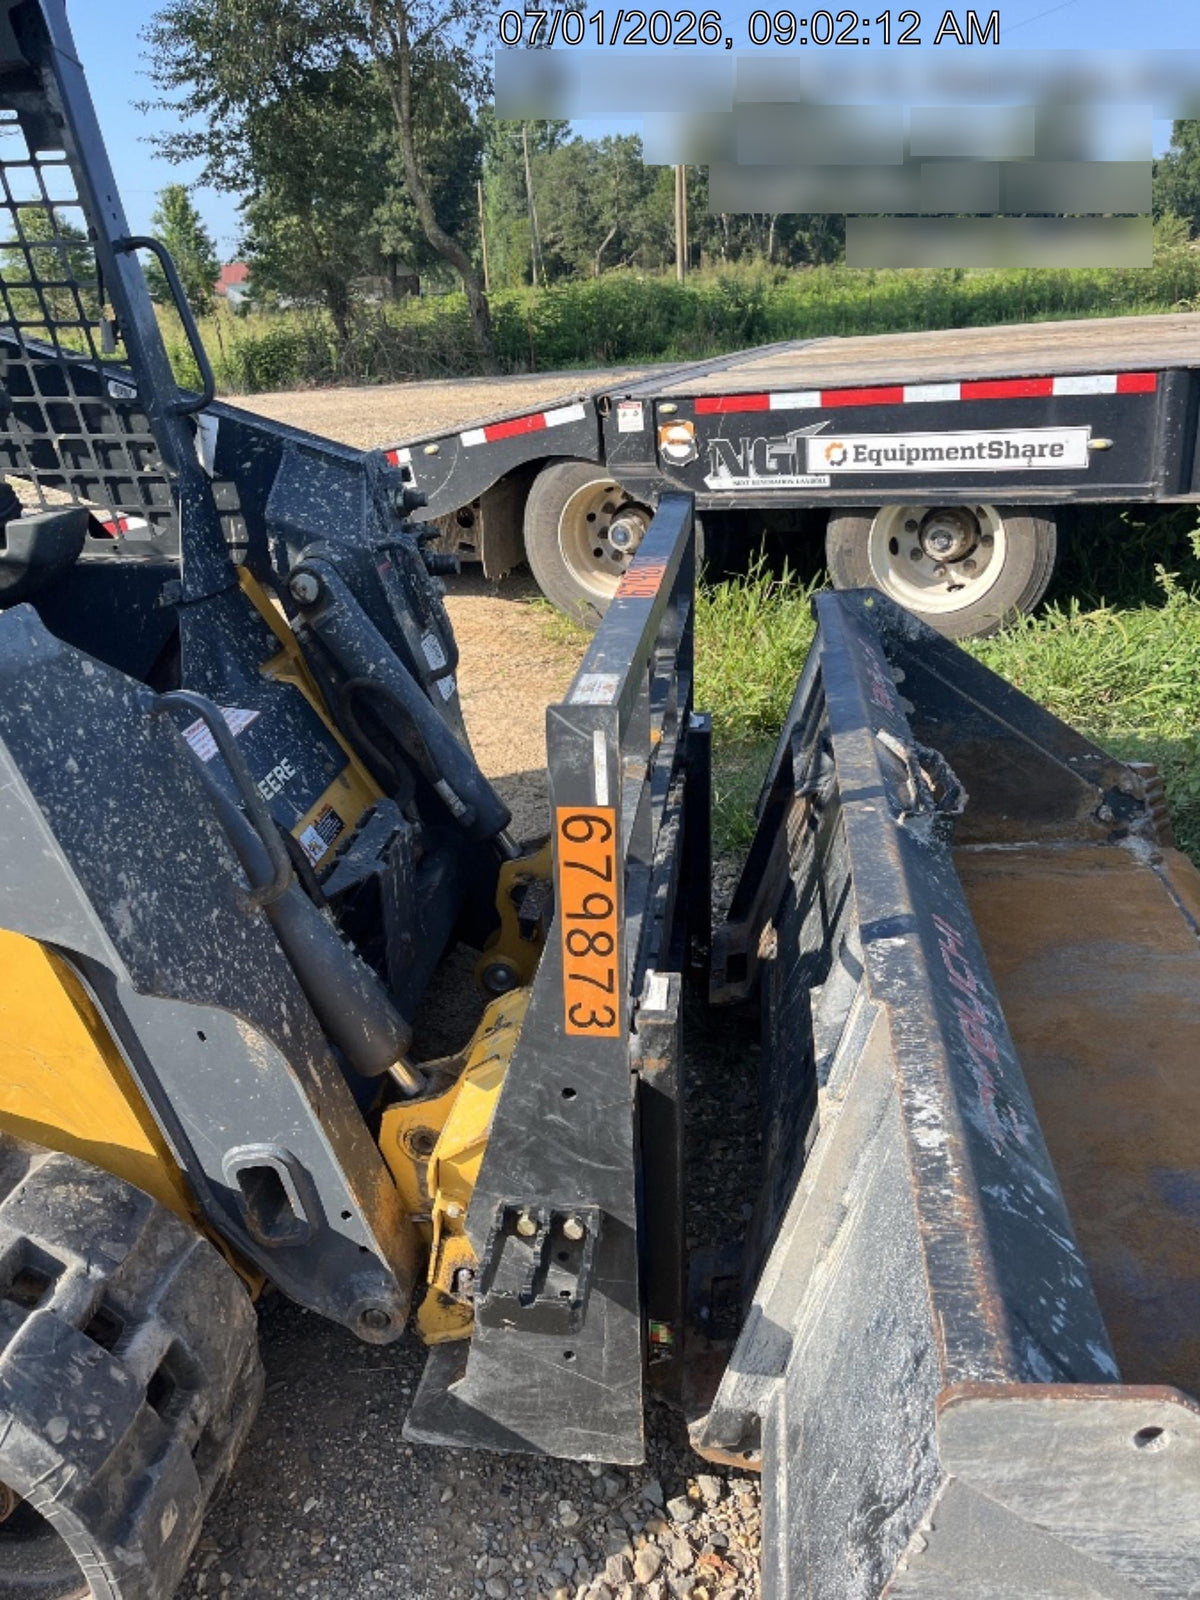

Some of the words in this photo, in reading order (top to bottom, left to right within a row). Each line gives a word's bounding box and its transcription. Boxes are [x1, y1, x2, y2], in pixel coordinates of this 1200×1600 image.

[853, 440, 1064, 466] EquipmentShare
[257, 756, 297, 801] EERE
[561, 814, 617, 1029] 679873
